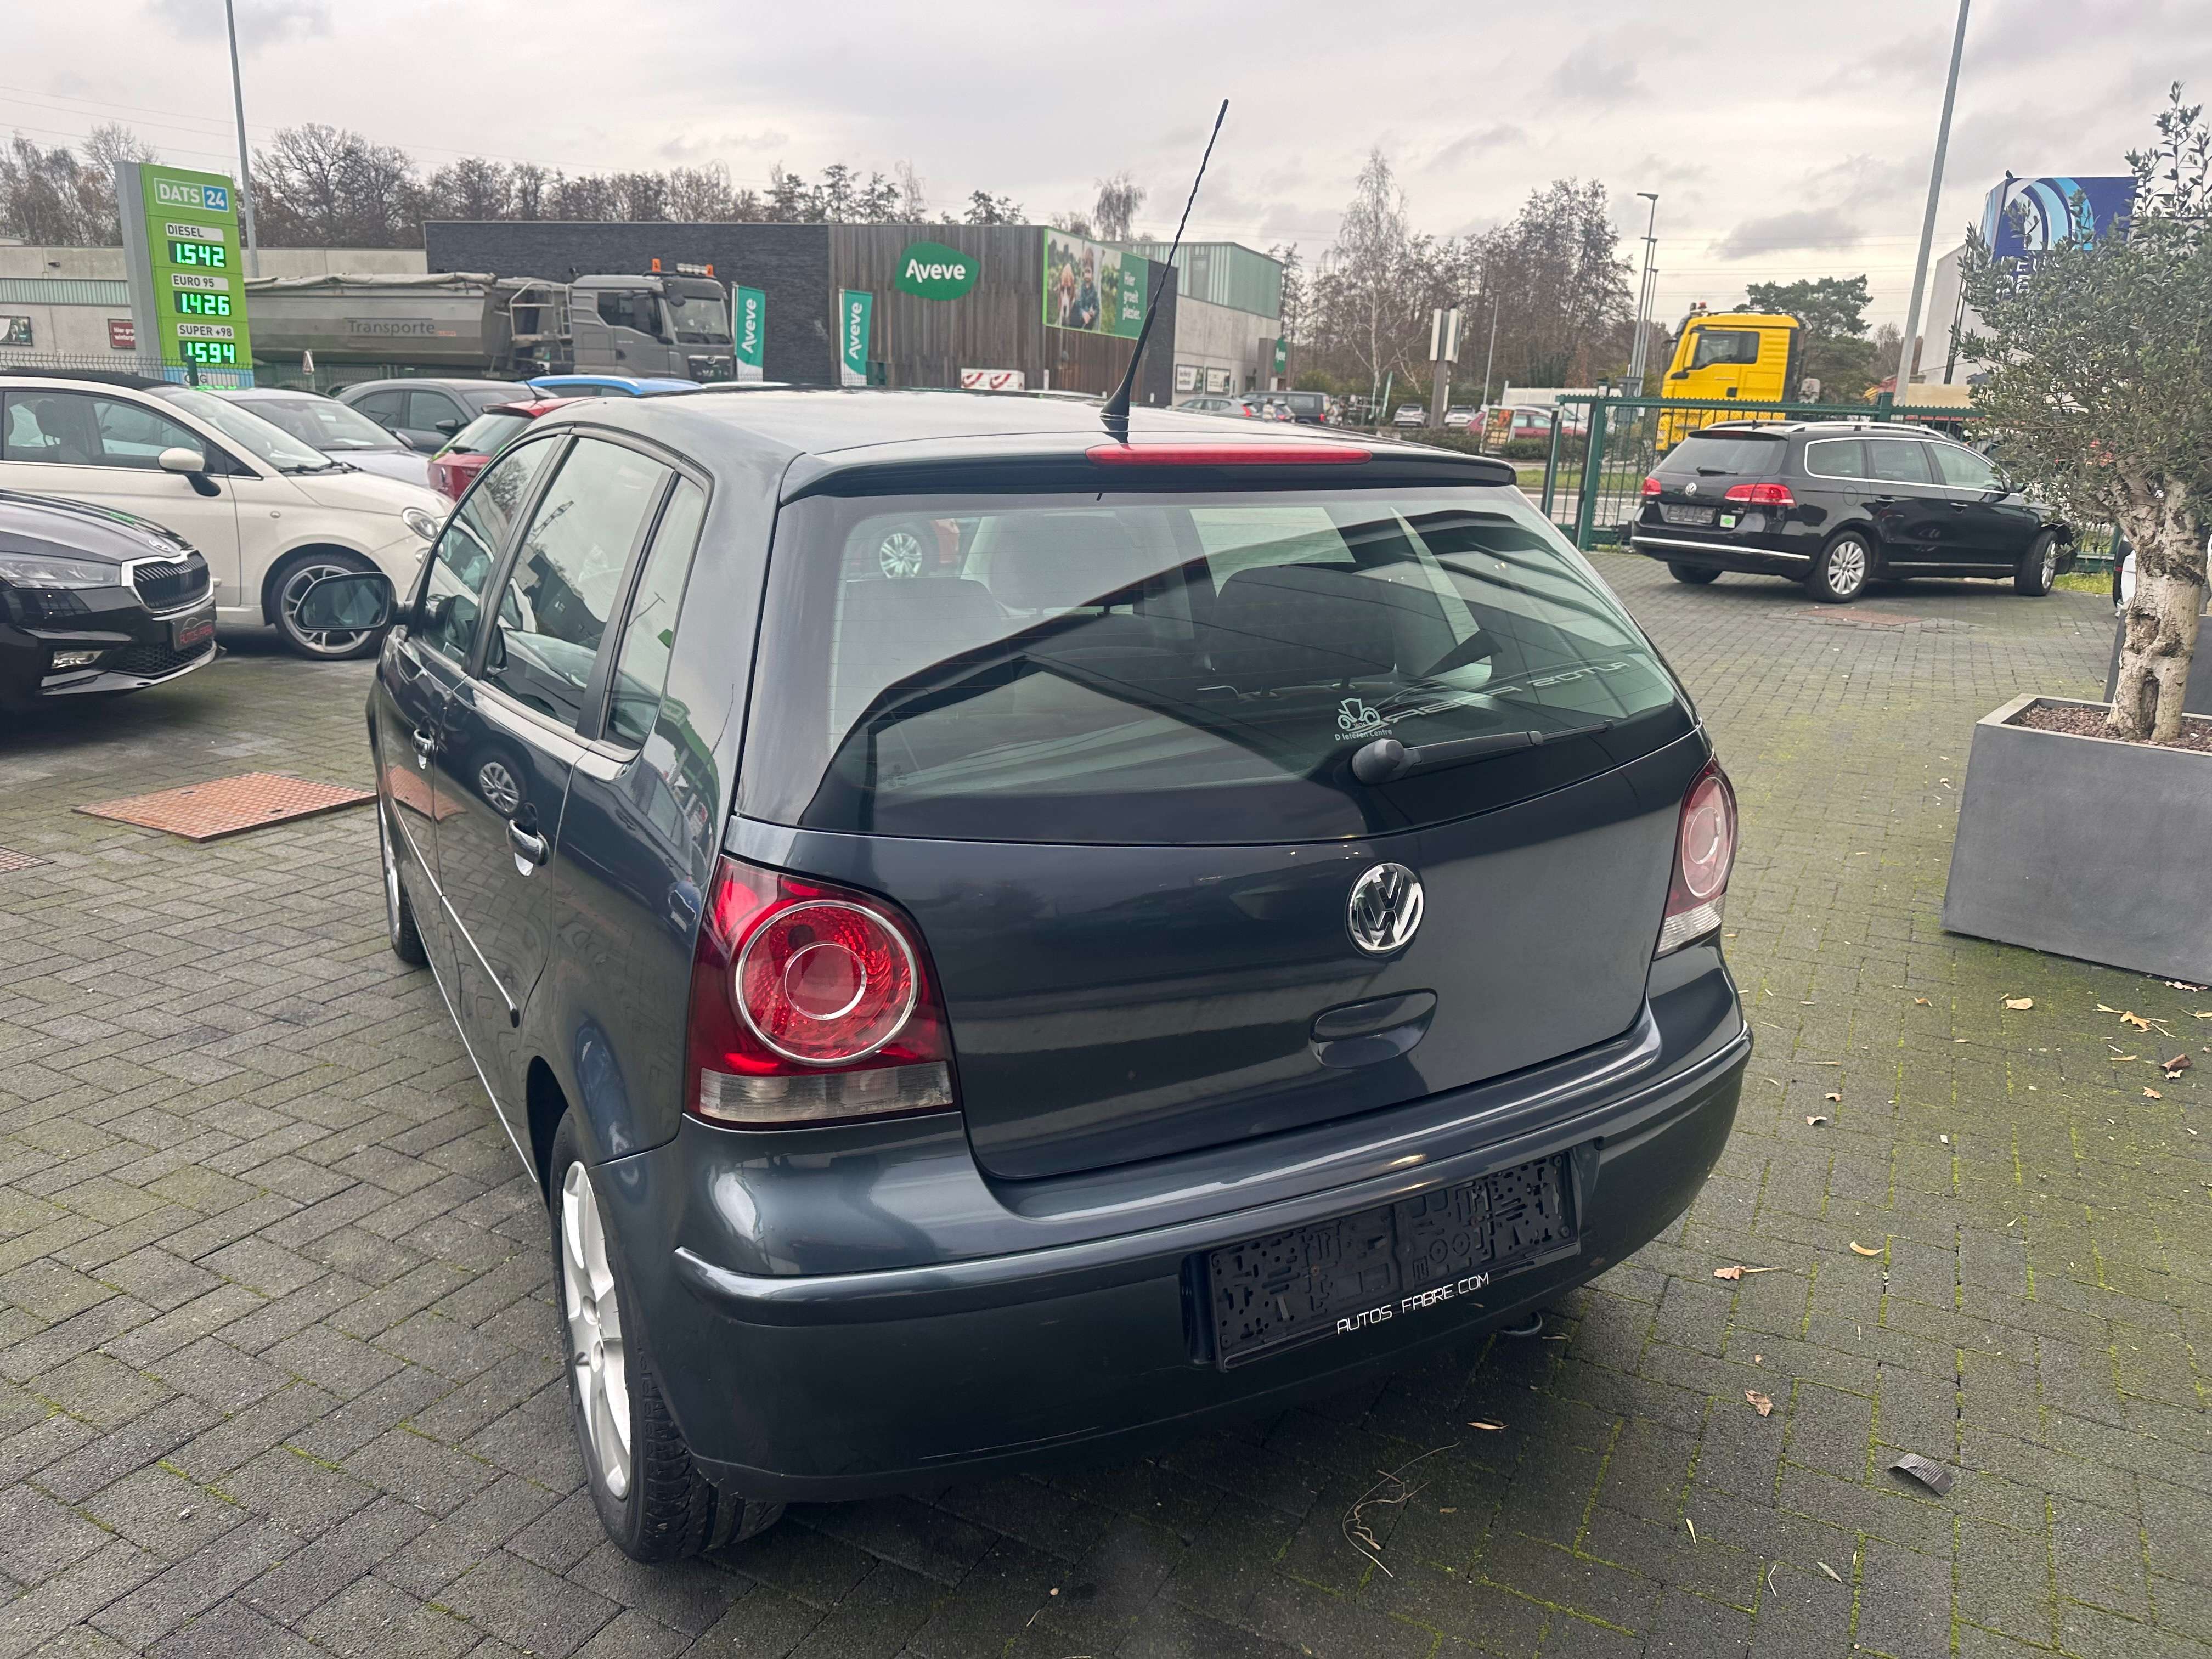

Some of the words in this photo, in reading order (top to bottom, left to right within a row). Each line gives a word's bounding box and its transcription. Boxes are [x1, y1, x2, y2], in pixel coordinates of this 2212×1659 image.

[159, 184, 200, 203] DATS
[206, 190, 225, 207] 24
[167, 224, 204, 238] DIESEL
[176, 243, 225, 267] 1.542
[173, 275, 200, 286] EURO
[202, 278, 214, 287] 95
[905, 259, 966, 283] Aveve
[182, 293, 230, 315] 1.426
[179, 325, 213, 336] SUPER
[216, 327, 232, 337] +98
[348, 320, 435, 336] Transporte
[741, 298, 757, 354] Aveve
[849, 302, 862, 360] Aveve
[1336, 1305, 1392, 1335] AUTOS
[1401, 1272, 1489, 1314] FABRE.COM
